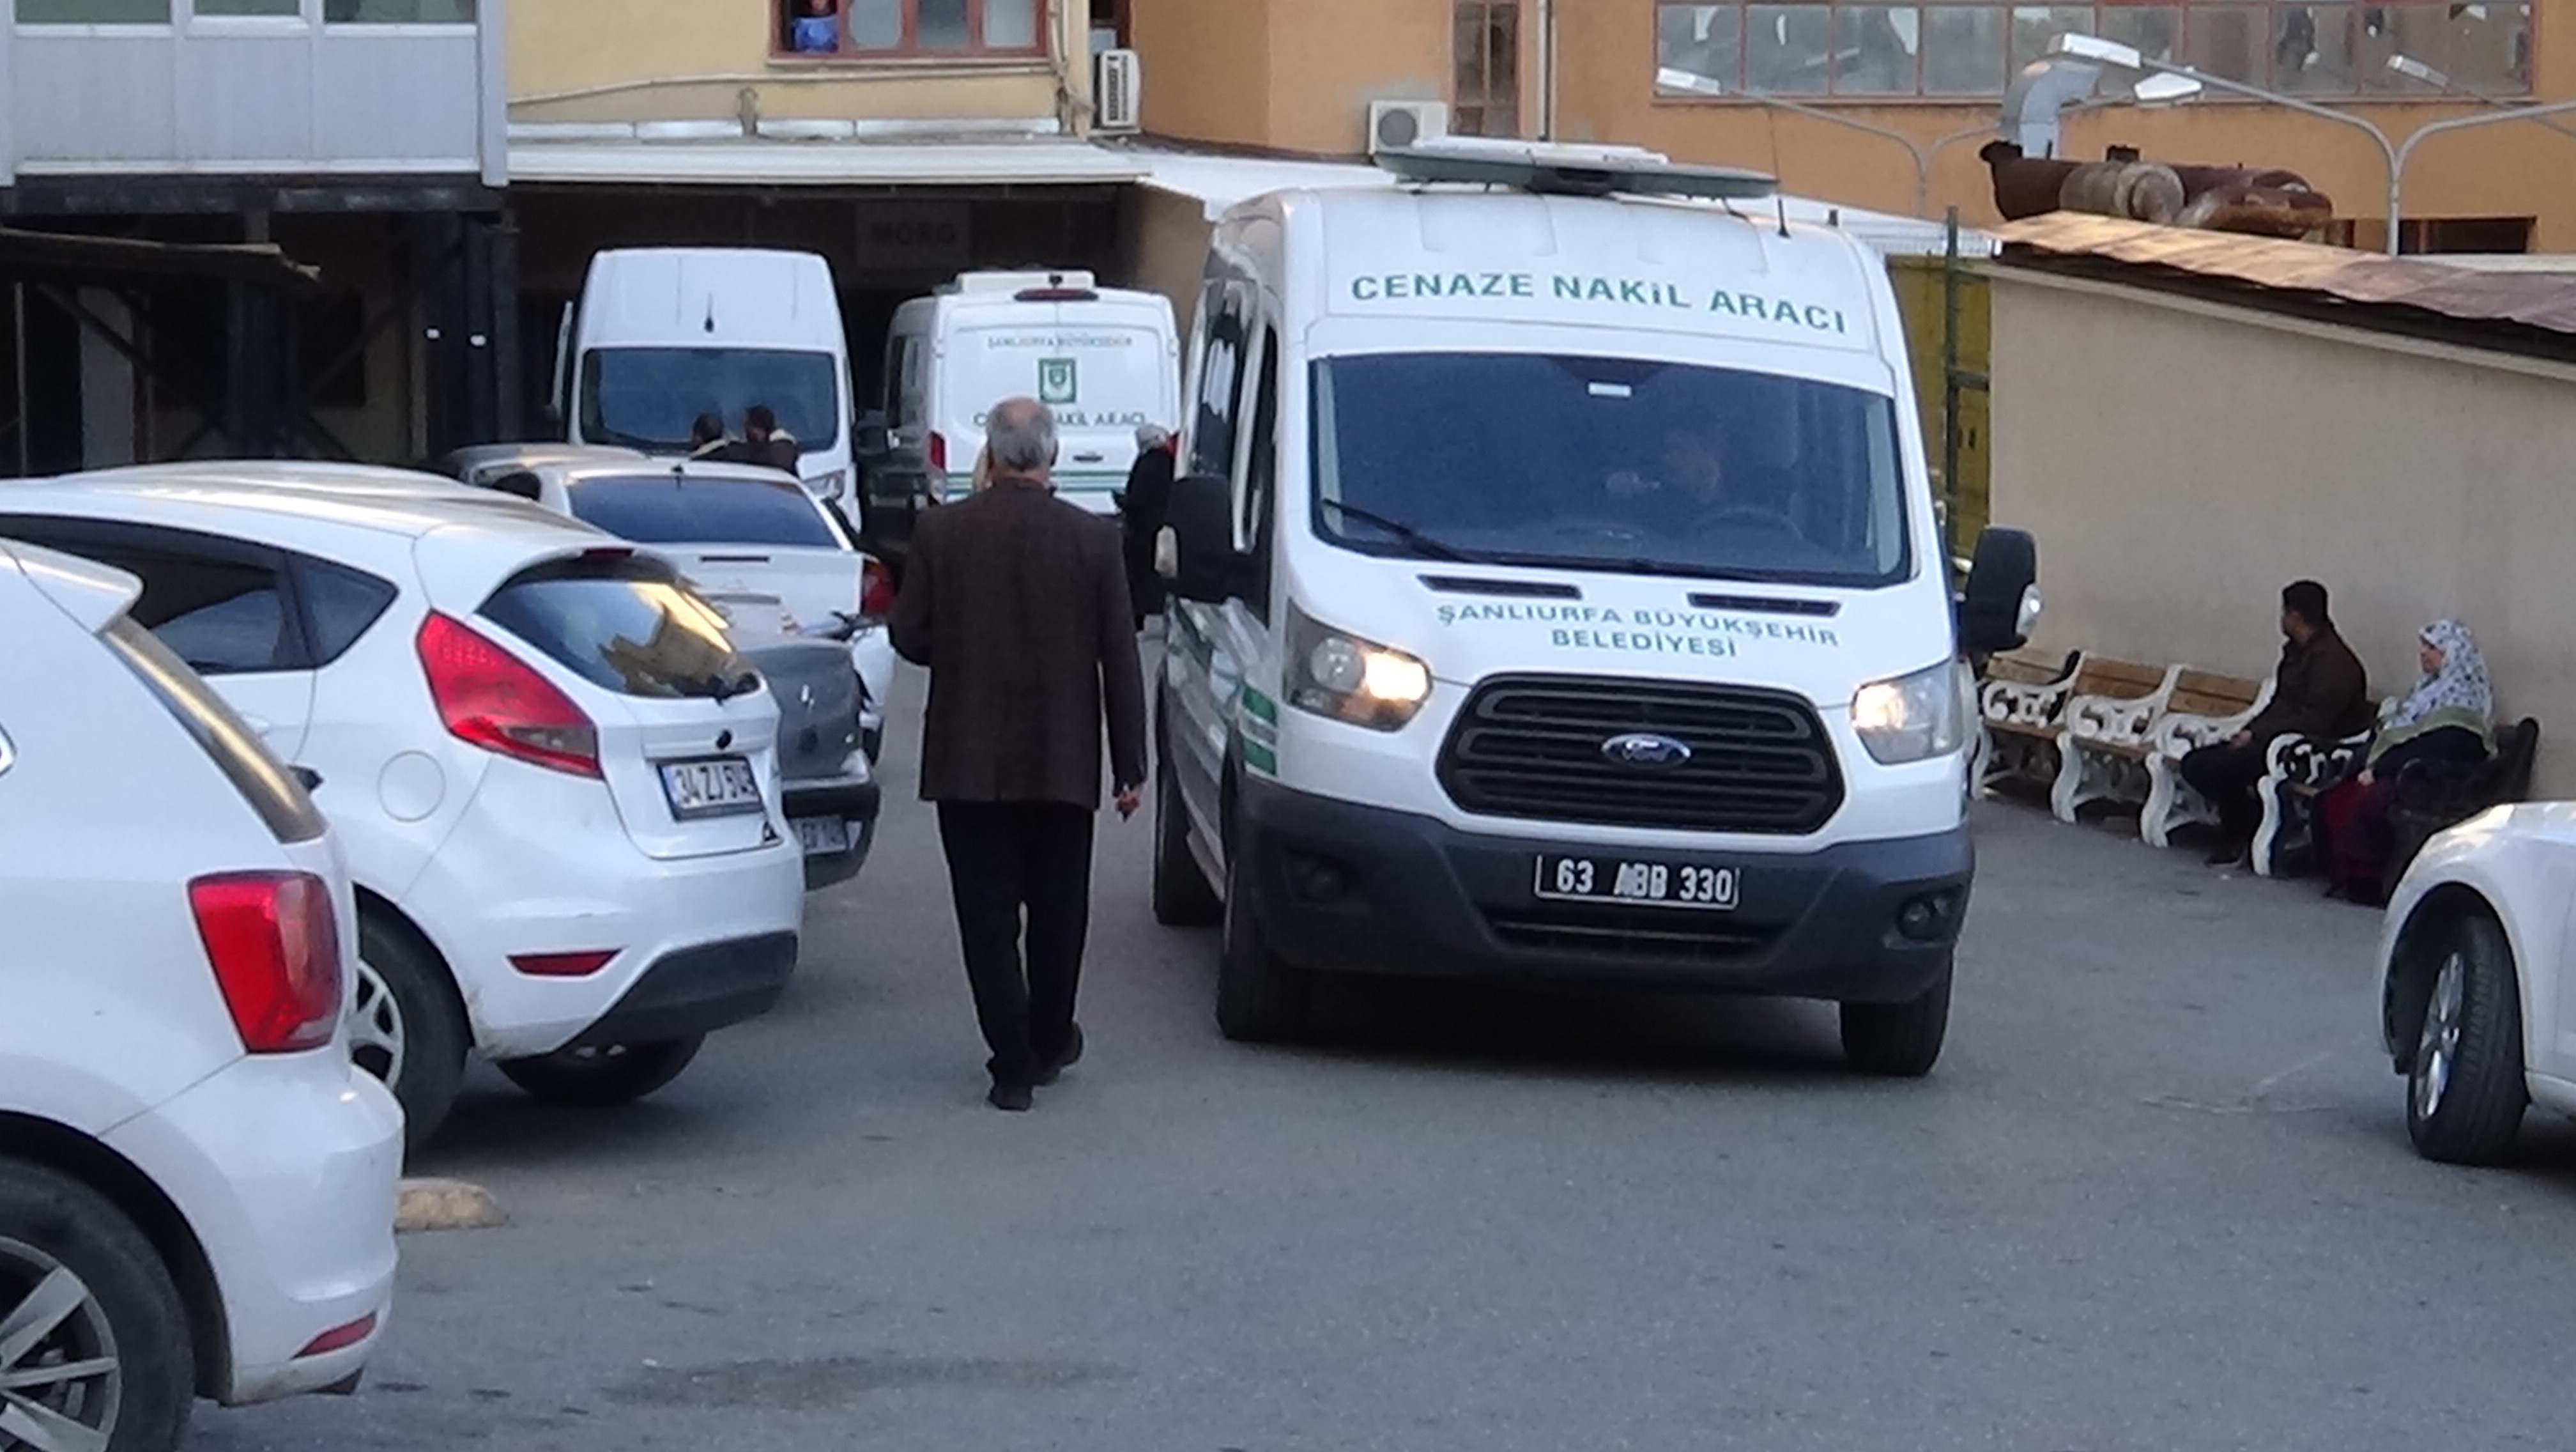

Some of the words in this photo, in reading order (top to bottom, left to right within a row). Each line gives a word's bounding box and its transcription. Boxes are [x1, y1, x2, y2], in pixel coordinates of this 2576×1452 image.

[1351, 273, 1535, 300] CENAZE
[1709, 290, 1848, 334] ARACI
[1436, 604, 1623, 626] ŞANLIURFA
[1552, 629, 1737, 657] BELEDİYESİ
[1557, 859, 1594, 893] 63
[1680, 867, 1733, 902] 330
